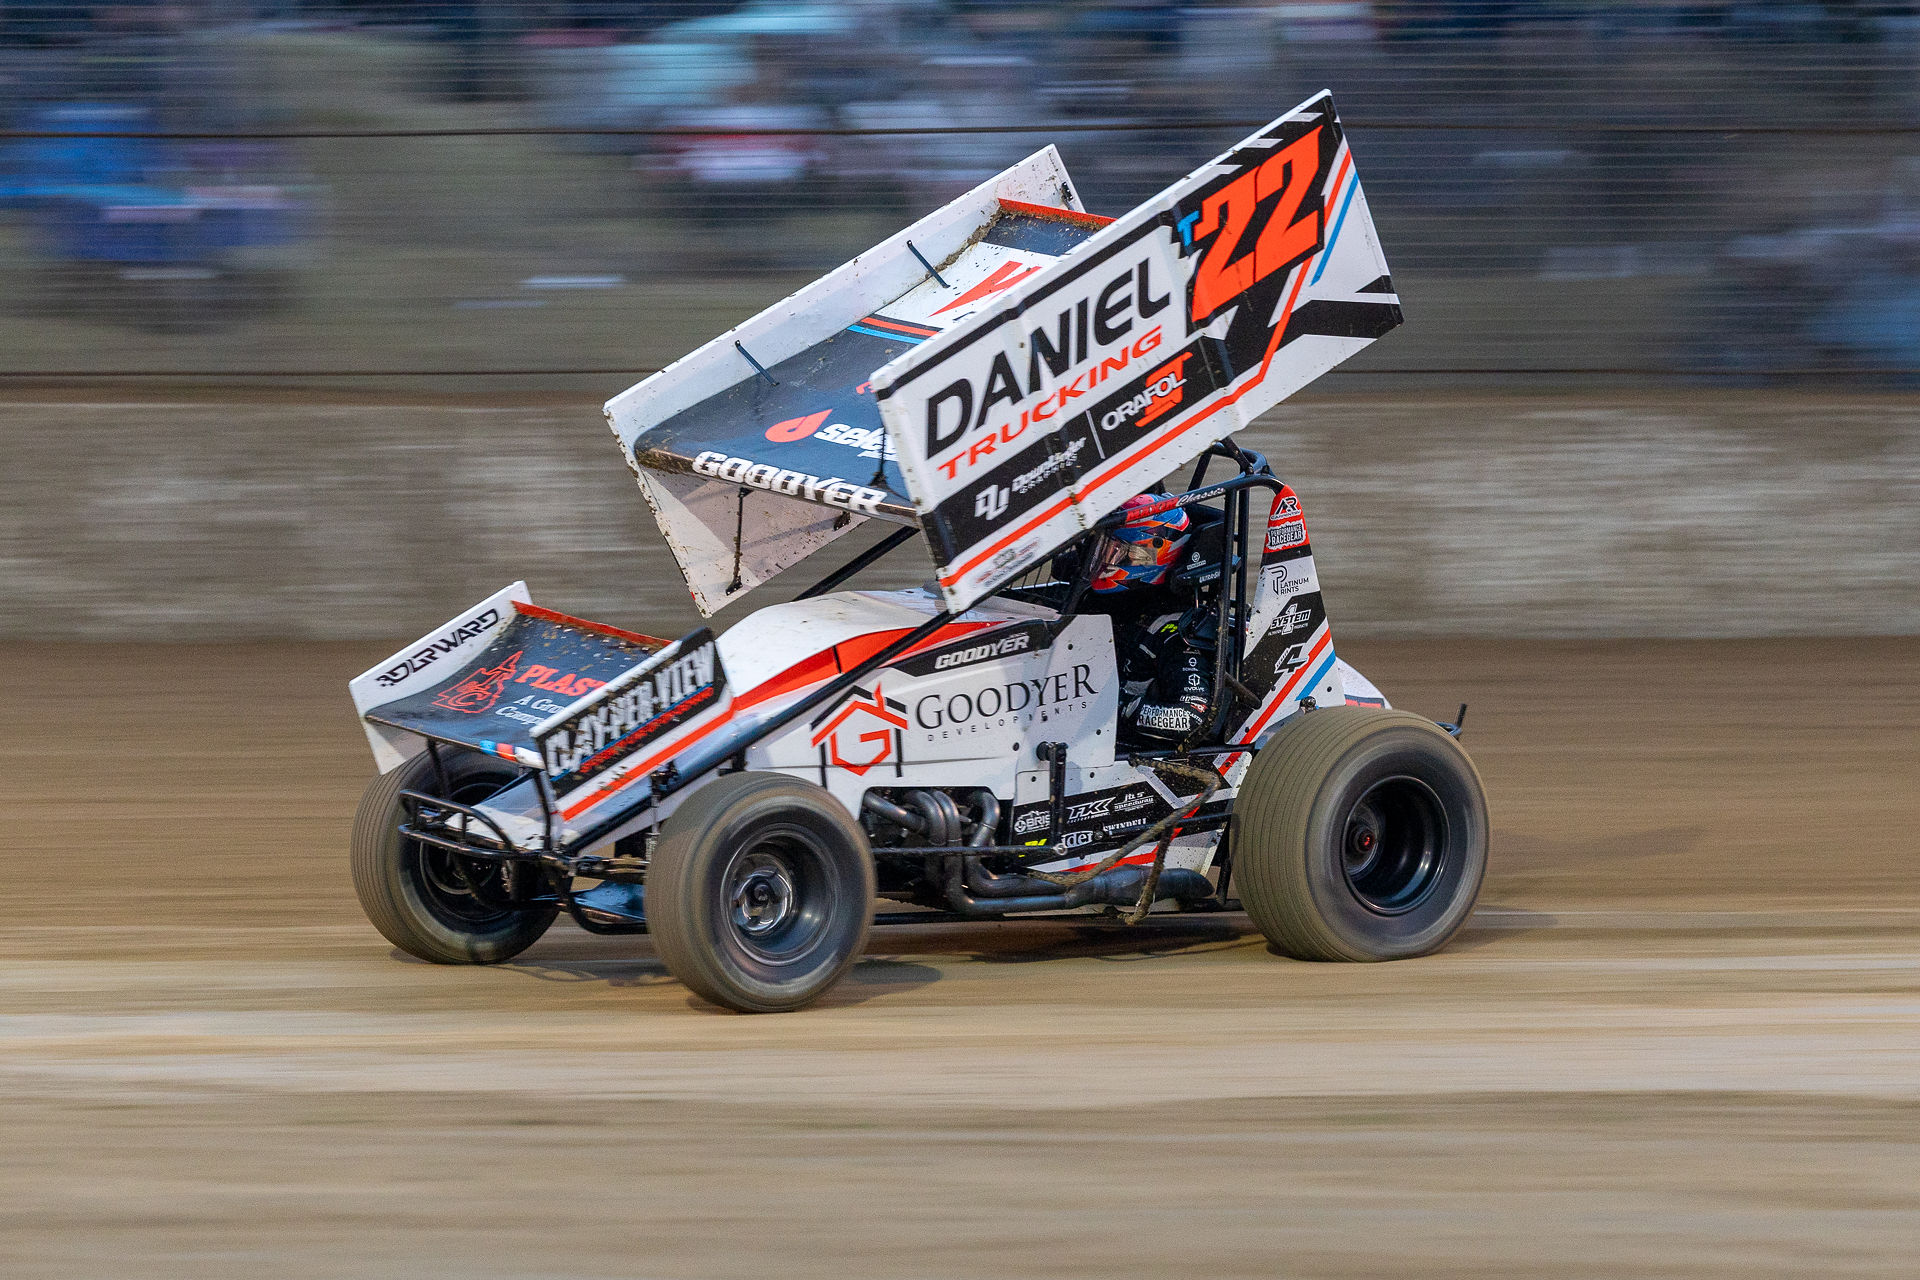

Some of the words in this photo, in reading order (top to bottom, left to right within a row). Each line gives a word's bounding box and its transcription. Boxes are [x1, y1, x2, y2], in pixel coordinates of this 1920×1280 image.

[926, 257, 1170, 459] DANIEL
[937, 325, 1163, 480] TRUCKING
[1100, 372, 1187, 431] ORAFOL
[692, 450, 887, 515] GOODYER
[1271, 524, 1302, 537] PERFORMANCE
[1272, 531, 1302, 546] RACEGEAR
[1272, 611, 1310, 627] SYSTEM
[934, 634, 1030, 670] GOODYER
[916, 664, 1099, 729] GOODYER
[1142, 705, 1188, 719] PERFORMANCE
[928, 702, 1087, 741] DEVELOPMENTS
[1139, 715, 1188, 729] RACEGEAR
